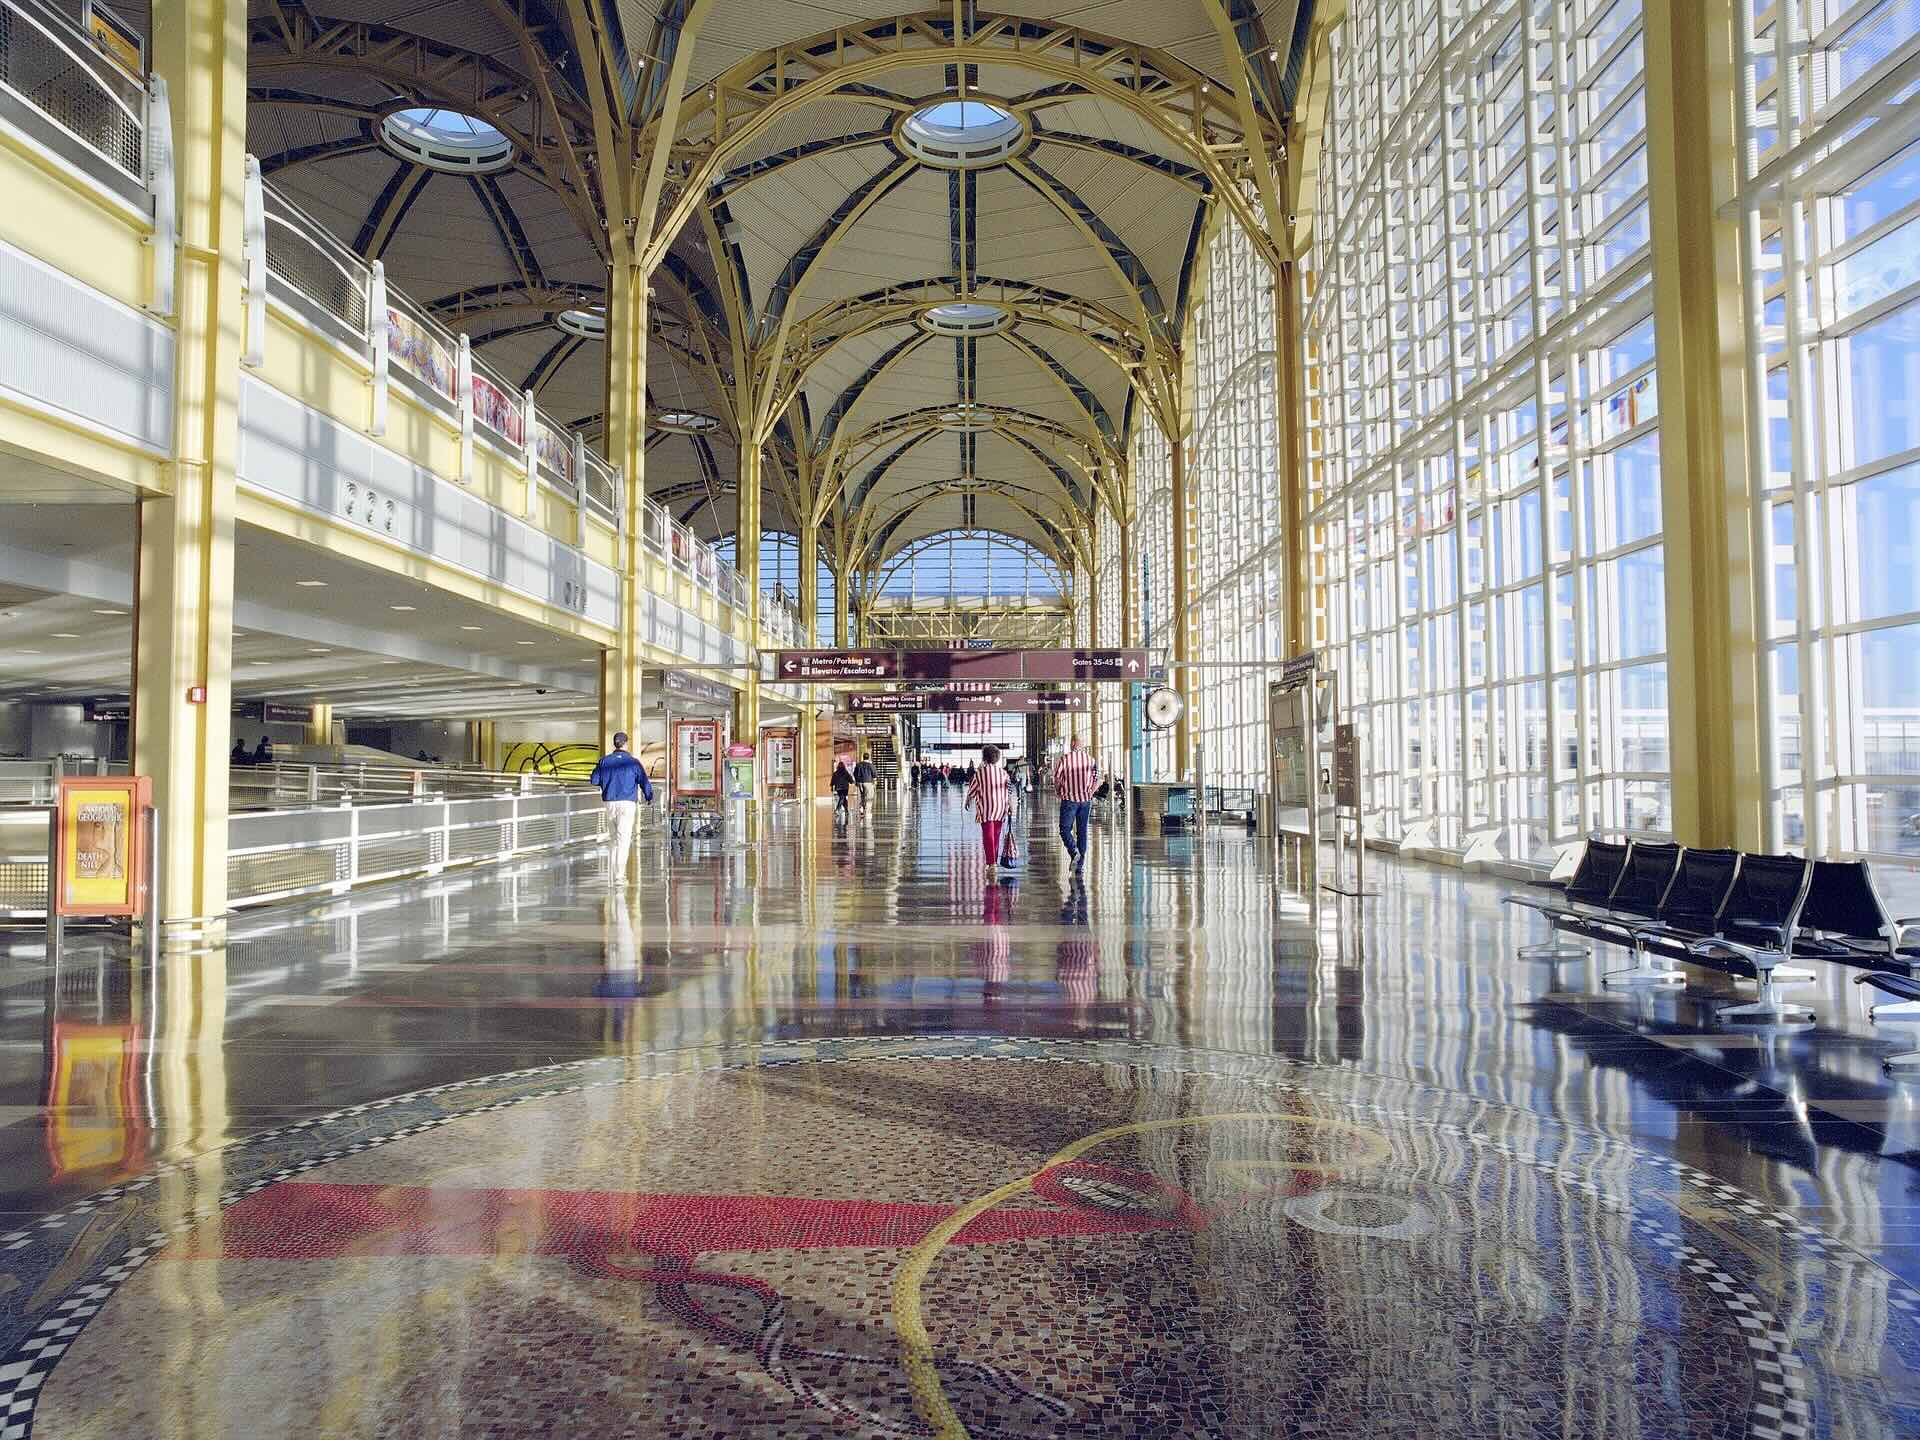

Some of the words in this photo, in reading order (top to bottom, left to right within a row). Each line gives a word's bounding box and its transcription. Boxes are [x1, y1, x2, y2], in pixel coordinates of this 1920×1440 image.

[811, 657, 863, 665] Metro/Parking
[1072, 658, 1092, 666] Gates
[1093, 658, 1114, 666] 35-45
[811, 667, 875, 675] Elevator/Escalator
